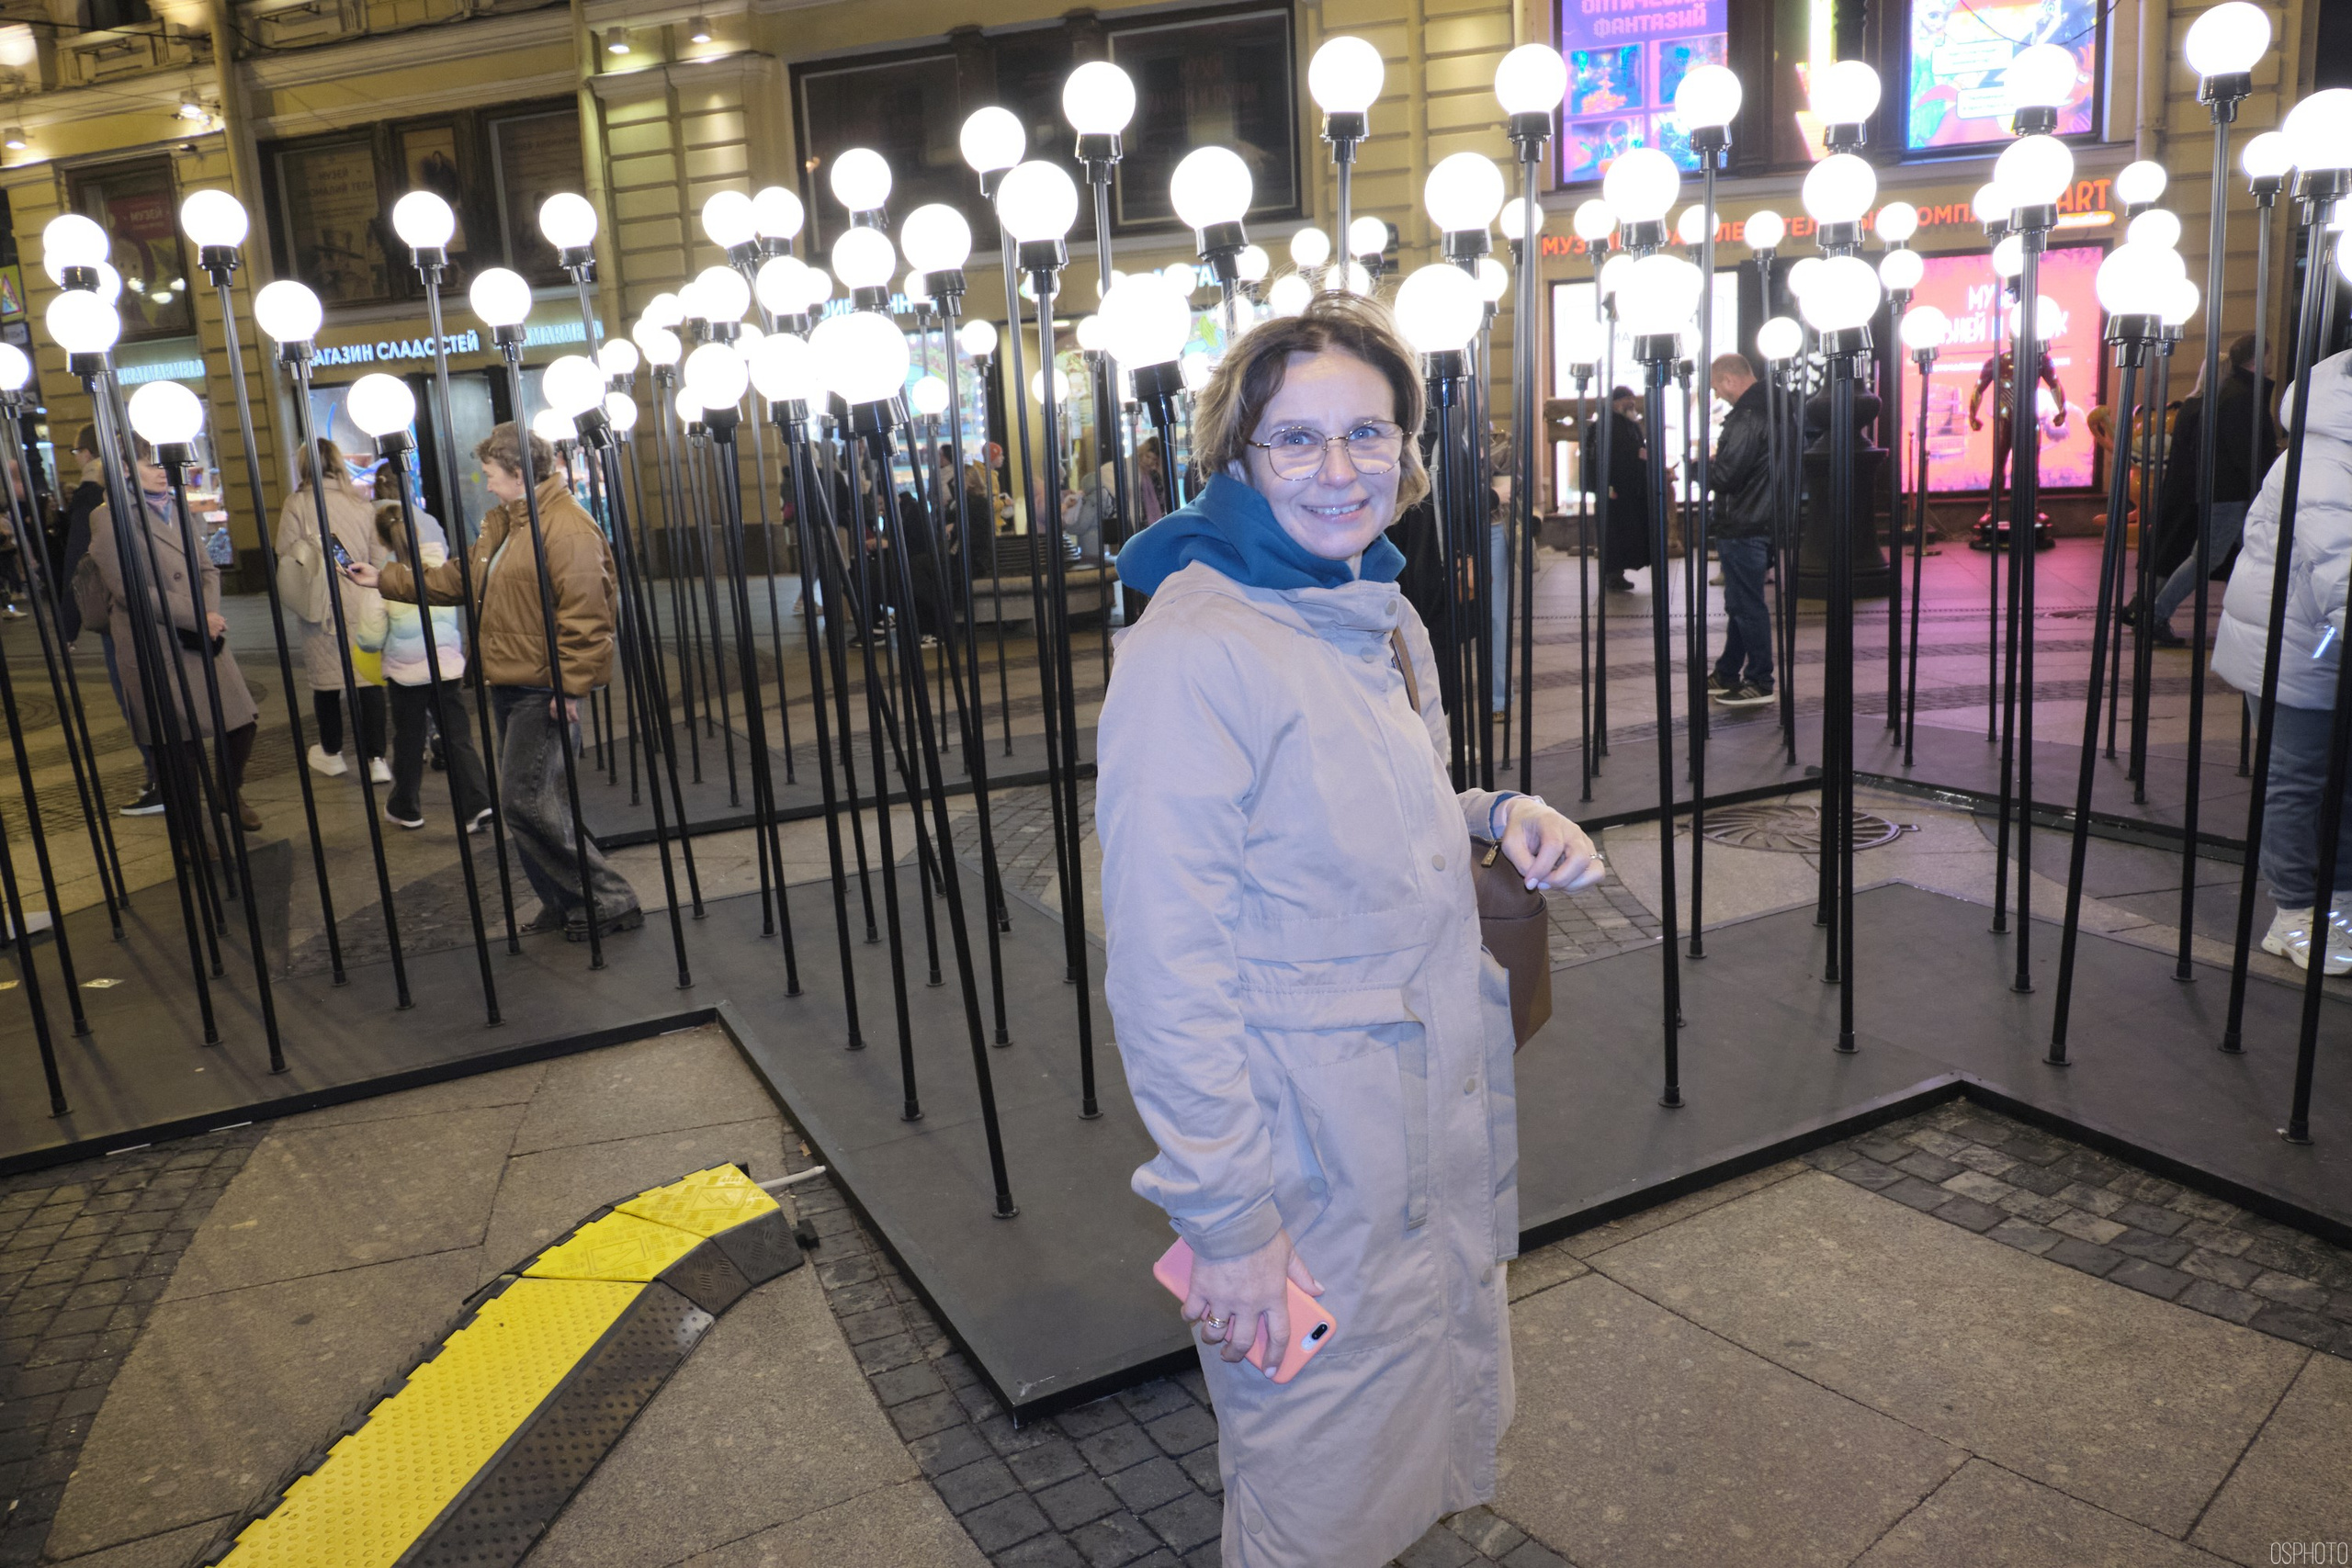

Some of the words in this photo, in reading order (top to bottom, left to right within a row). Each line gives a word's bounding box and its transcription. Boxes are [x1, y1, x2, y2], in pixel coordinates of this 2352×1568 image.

[1593, 3, 1707, 38] ФАНТАЗИЙ
[310, 344, 375, 367] АГАЗИН
[376, 329, 481, 360] СЛАДОСТЕЙ
